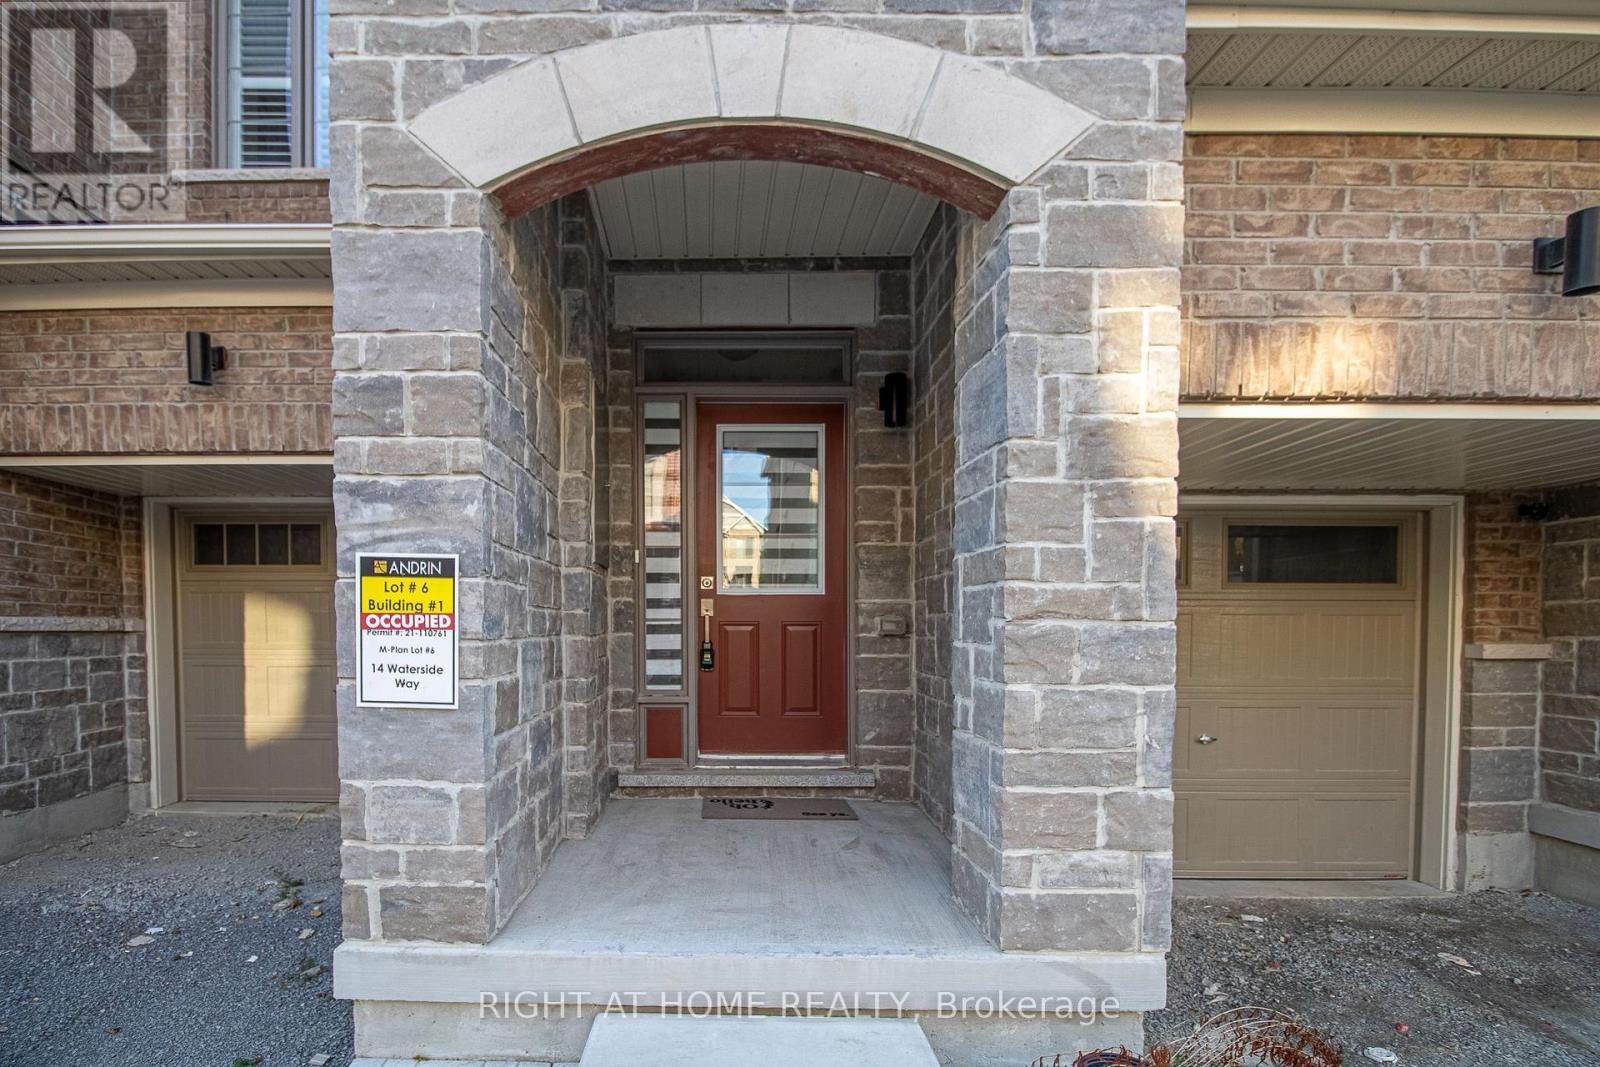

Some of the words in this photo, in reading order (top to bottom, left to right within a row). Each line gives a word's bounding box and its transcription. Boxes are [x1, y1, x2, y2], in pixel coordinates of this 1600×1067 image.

[389, 561, 442, 575] ANDRIN
[384, 581, 404, 593] Lot
[409, 582, 417, 592] #
[421, 582, 429, 594] 6
[368, 599, 424, 614] Building
[428, 600, 444, 612] #1
[365, 614, 451, 629] OCCUPIED
[366, 629, 393, 637] Permit
[405, 629, 447, 638] 21-110761
[379, 646, 409, 654] M-Plan
[411, 646, 423, 654] Lot
[425, 646, 435, 654] #6
[371, 663, 384, 673] 14
[387, 663, 444, 675] Waterside
[395, 678, 420, 691] Way
